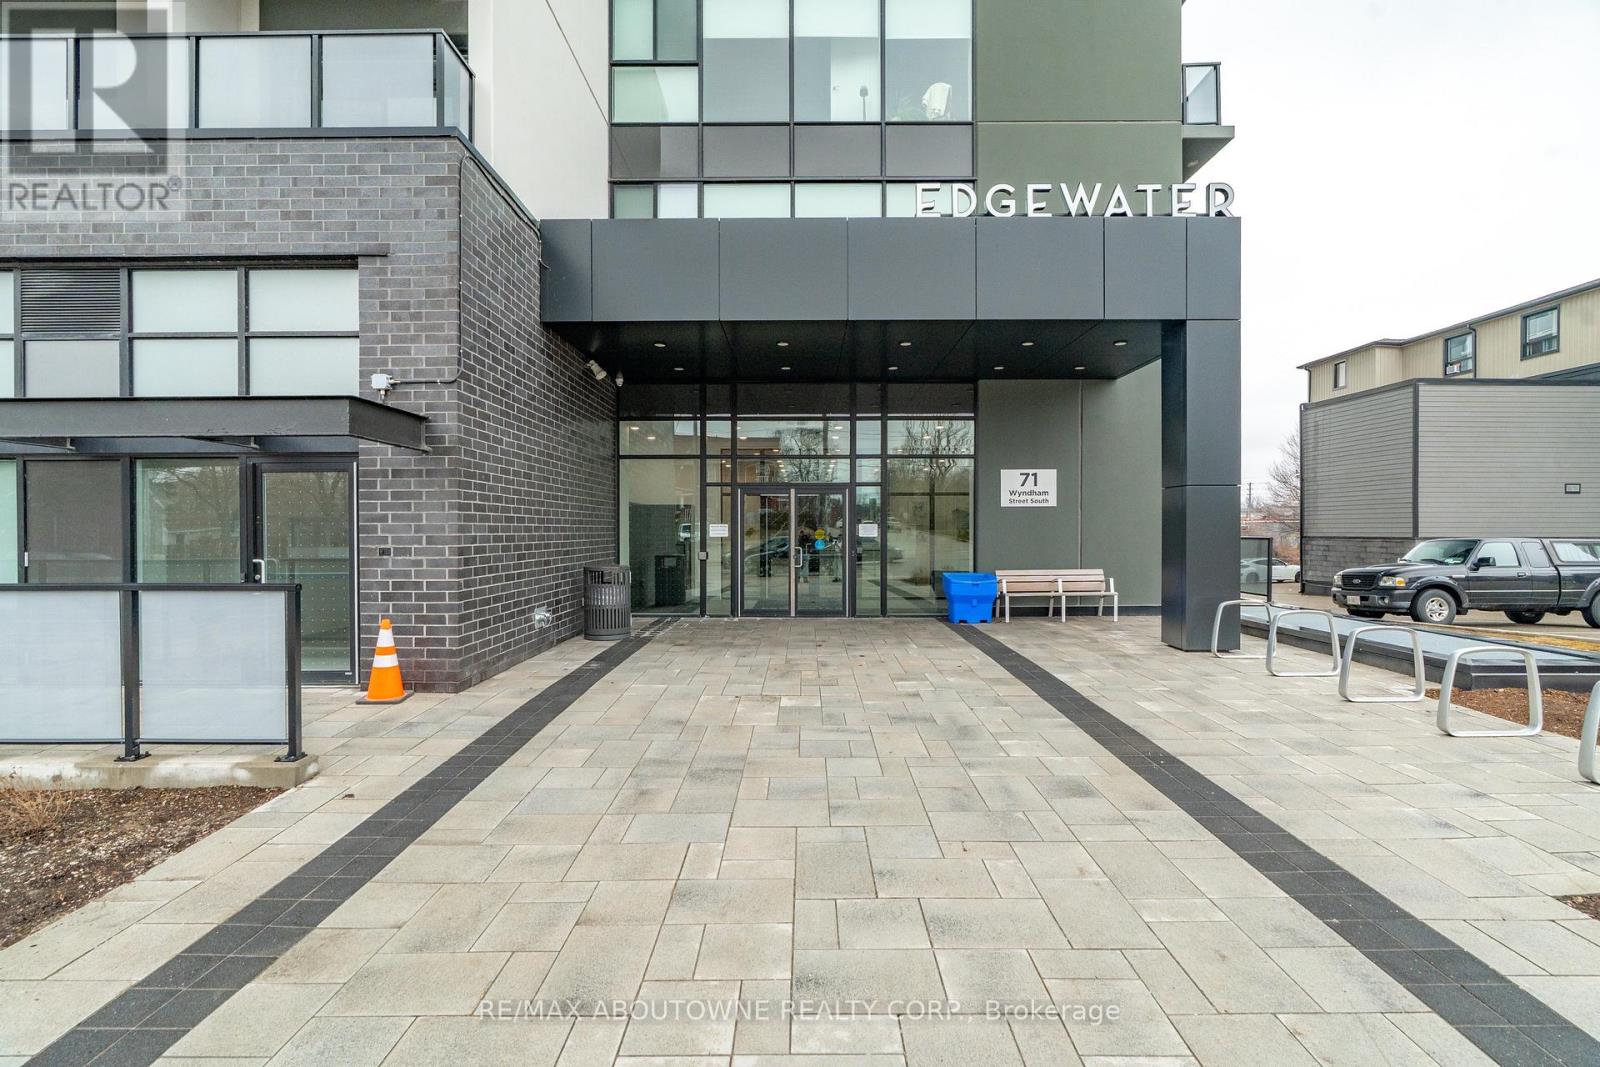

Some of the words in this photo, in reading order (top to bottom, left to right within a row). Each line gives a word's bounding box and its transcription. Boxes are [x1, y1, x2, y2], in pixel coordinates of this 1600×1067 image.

[914, 182, 1236, 218] EDGEWATER
[1019, 472, 1038, 487] 71
[1008, 489, 1049, 497] Wyndham
